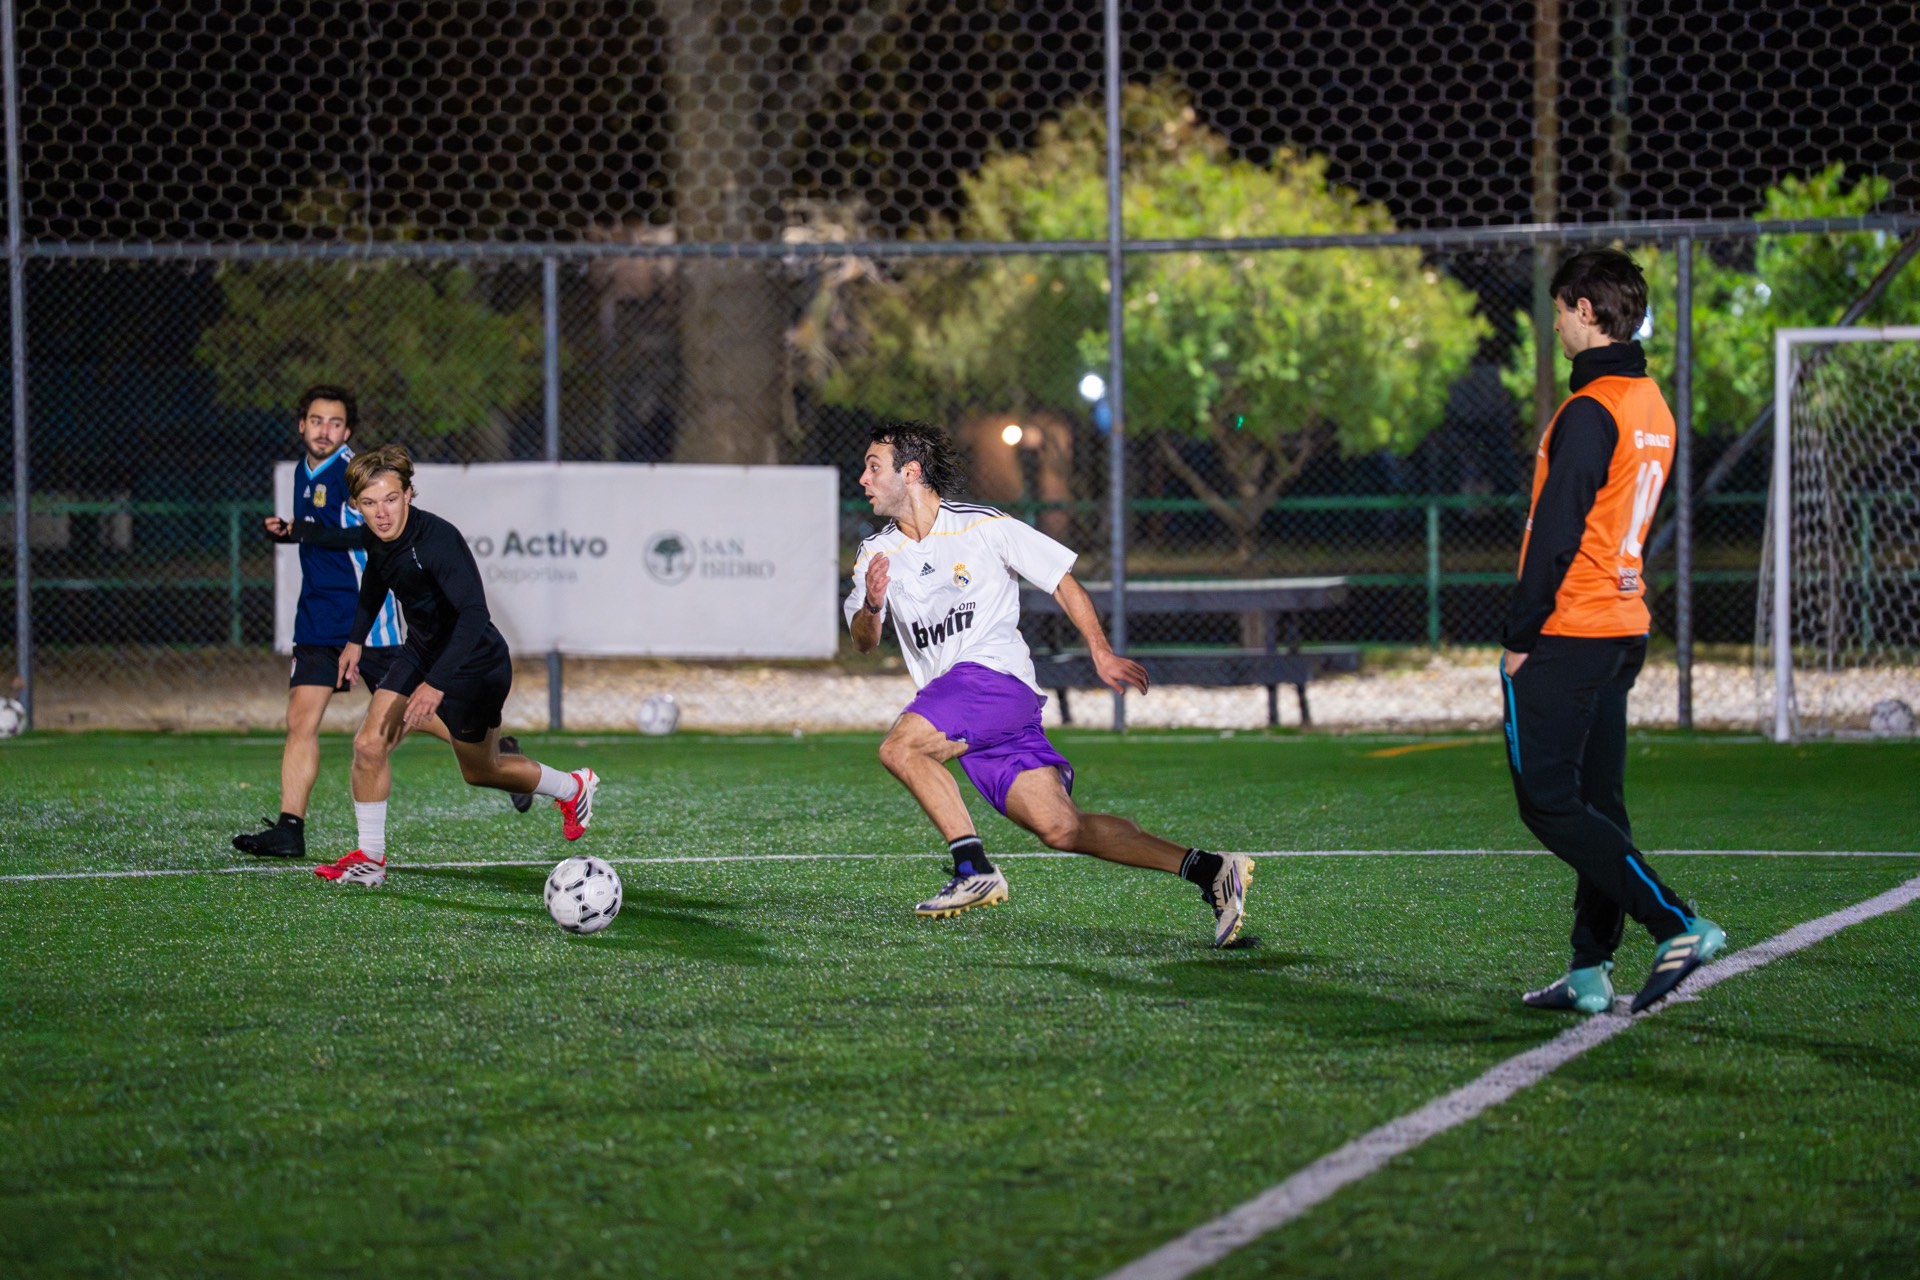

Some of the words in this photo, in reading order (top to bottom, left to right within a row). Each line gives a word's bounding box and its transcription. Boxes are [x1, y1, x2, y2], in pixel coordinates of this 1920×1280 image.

[503, 530, 607, 557] Activo
[701, 537, 744, 556] SAN
[702, 560, 775, 578] ISIDRO
[912, 608, 974, 649] bwin
